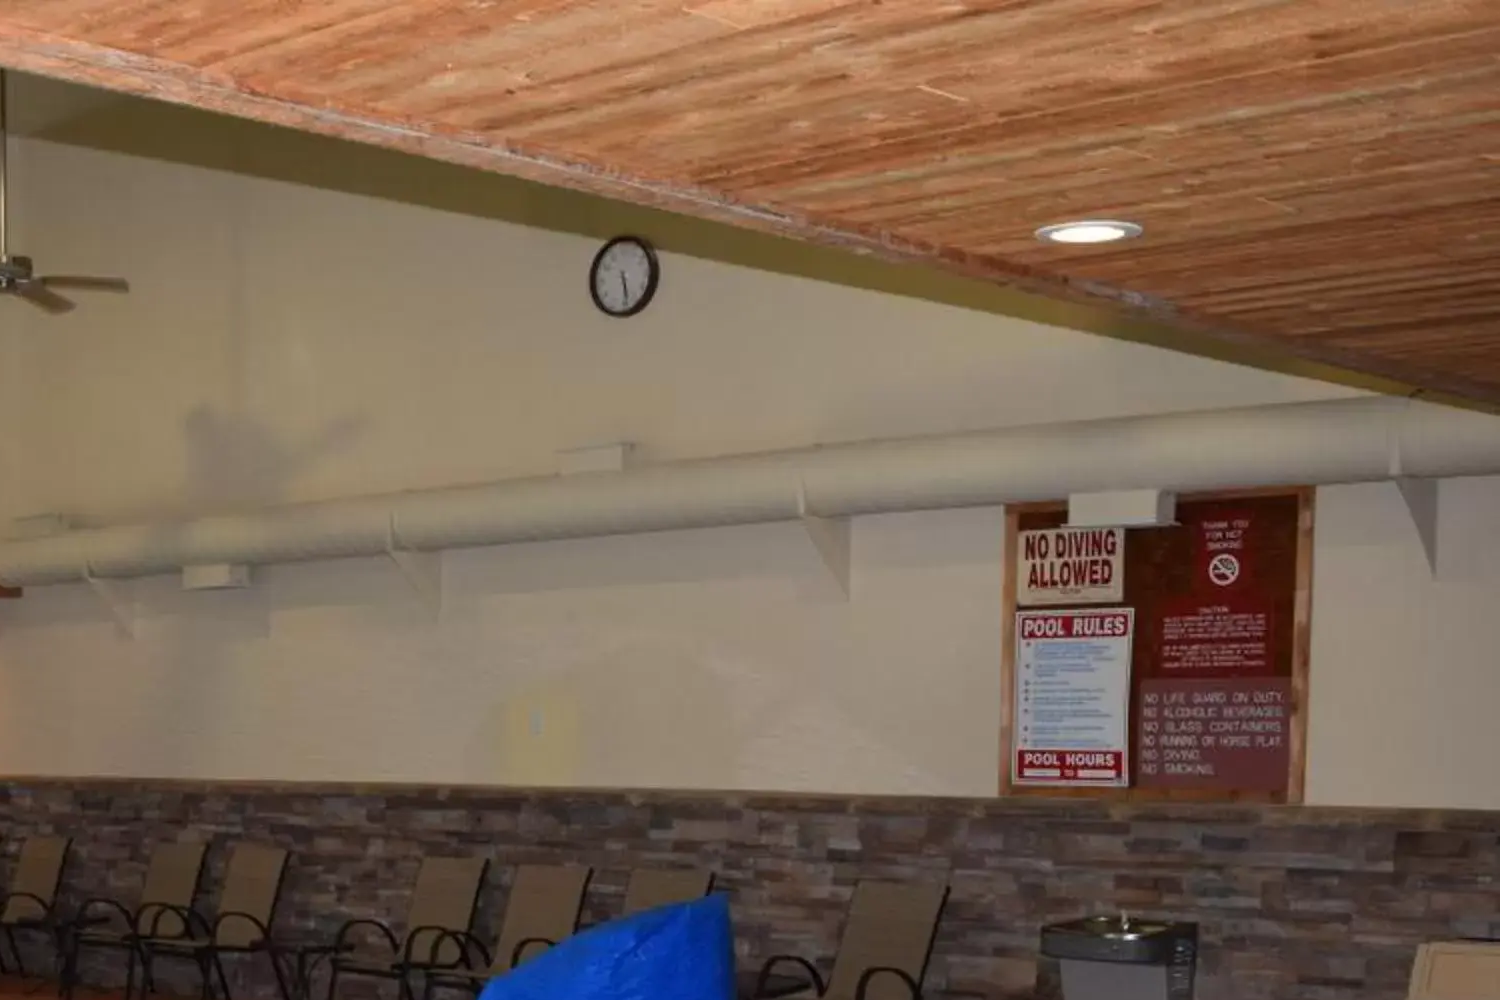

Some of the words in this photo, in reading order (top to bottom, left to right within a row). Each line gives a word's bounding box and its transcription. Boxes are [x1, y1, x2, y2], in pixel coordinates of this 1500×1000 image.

[1025, 534, 1049, 560] NO
[1055, 530, 1117, 559] DIVING
[1028, 559, 1113, 588] ALLOWED
[1023, 619, 1064, 637] POOL
[1073, 616, 1125, 636] RULES
[1145, 693, 1158, 703] NO
[1163, 692, 1186, 703] LIFE
[1193, 693, 1226, 703] GUARD
[1232, 693, 1248, 703] ON
[1143, 707, 1157, 718] NO
[1164, 706, 1218, 718] ALCOHOLIC
[1143, 721, 1159, 732] NO
[1164, 721, 1202, 733] GLASS
[1143, 736, 1155, 747] NO
[1160, 736, 1198, 747] RUNNING
[1201, 736, 1215, 747] OR
[1220, 736, 1250, 747] HORSE
[1024, 753, 1061, 766] POOL
[1065, 753, 1115, 767] HOURS
[1142, 750, 1159, 760] NO
[1142, 763, 1157, 774] NO
